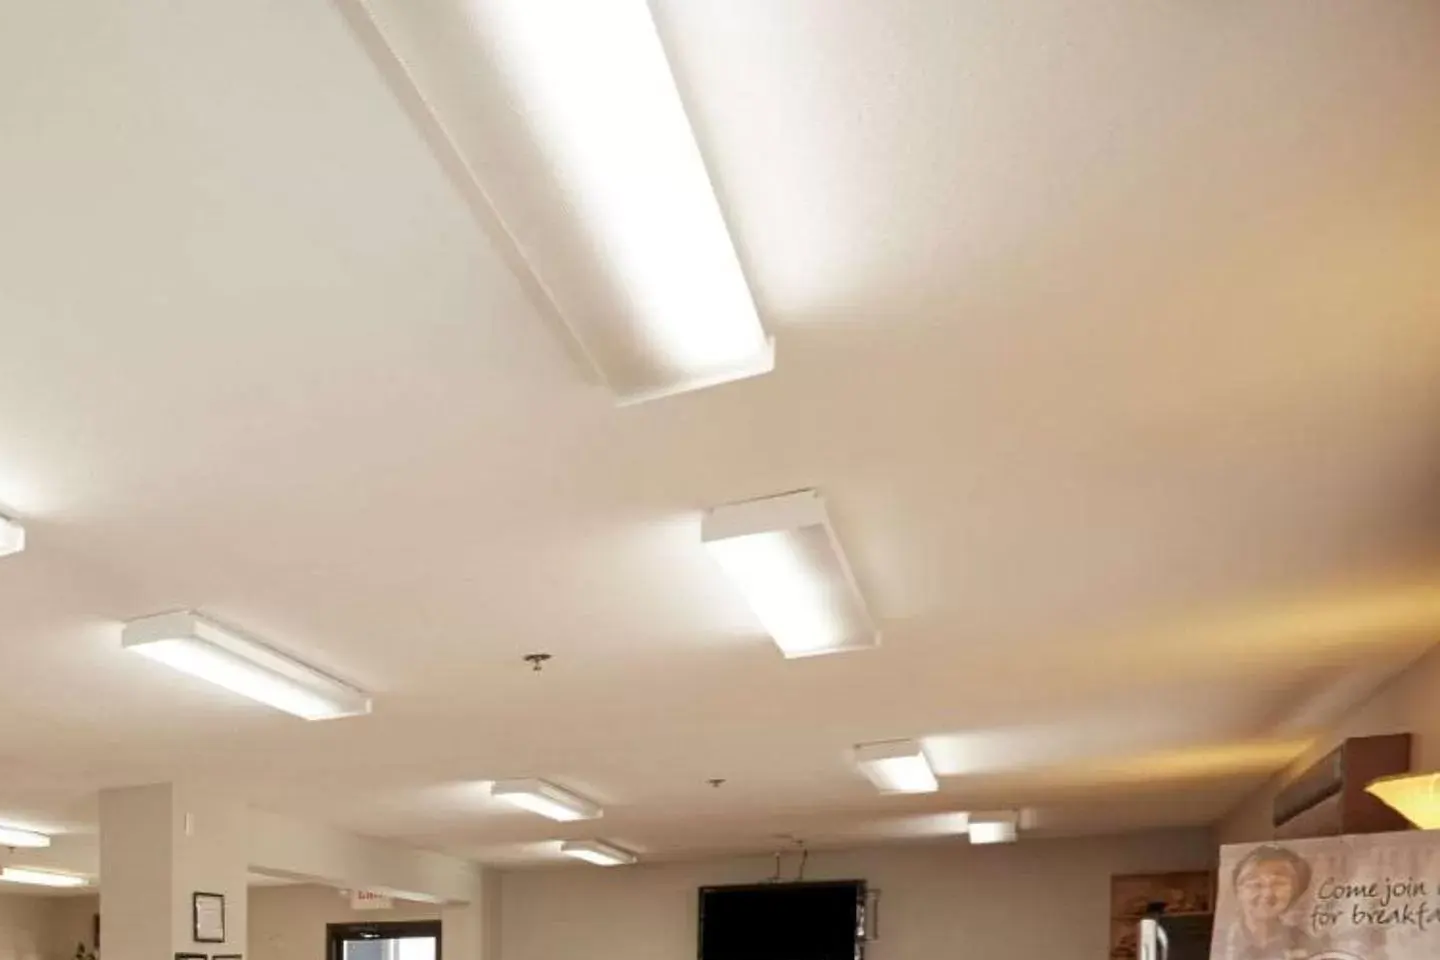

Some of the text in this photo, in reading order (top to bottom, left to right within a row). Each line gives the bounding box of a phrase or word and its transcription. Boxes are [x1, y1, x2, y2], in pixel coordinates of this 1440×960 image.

[1318, 876, 1379, 900] Come
[1379, 876, 1427, 907] join
[1310, 903, 1343, 935] for
